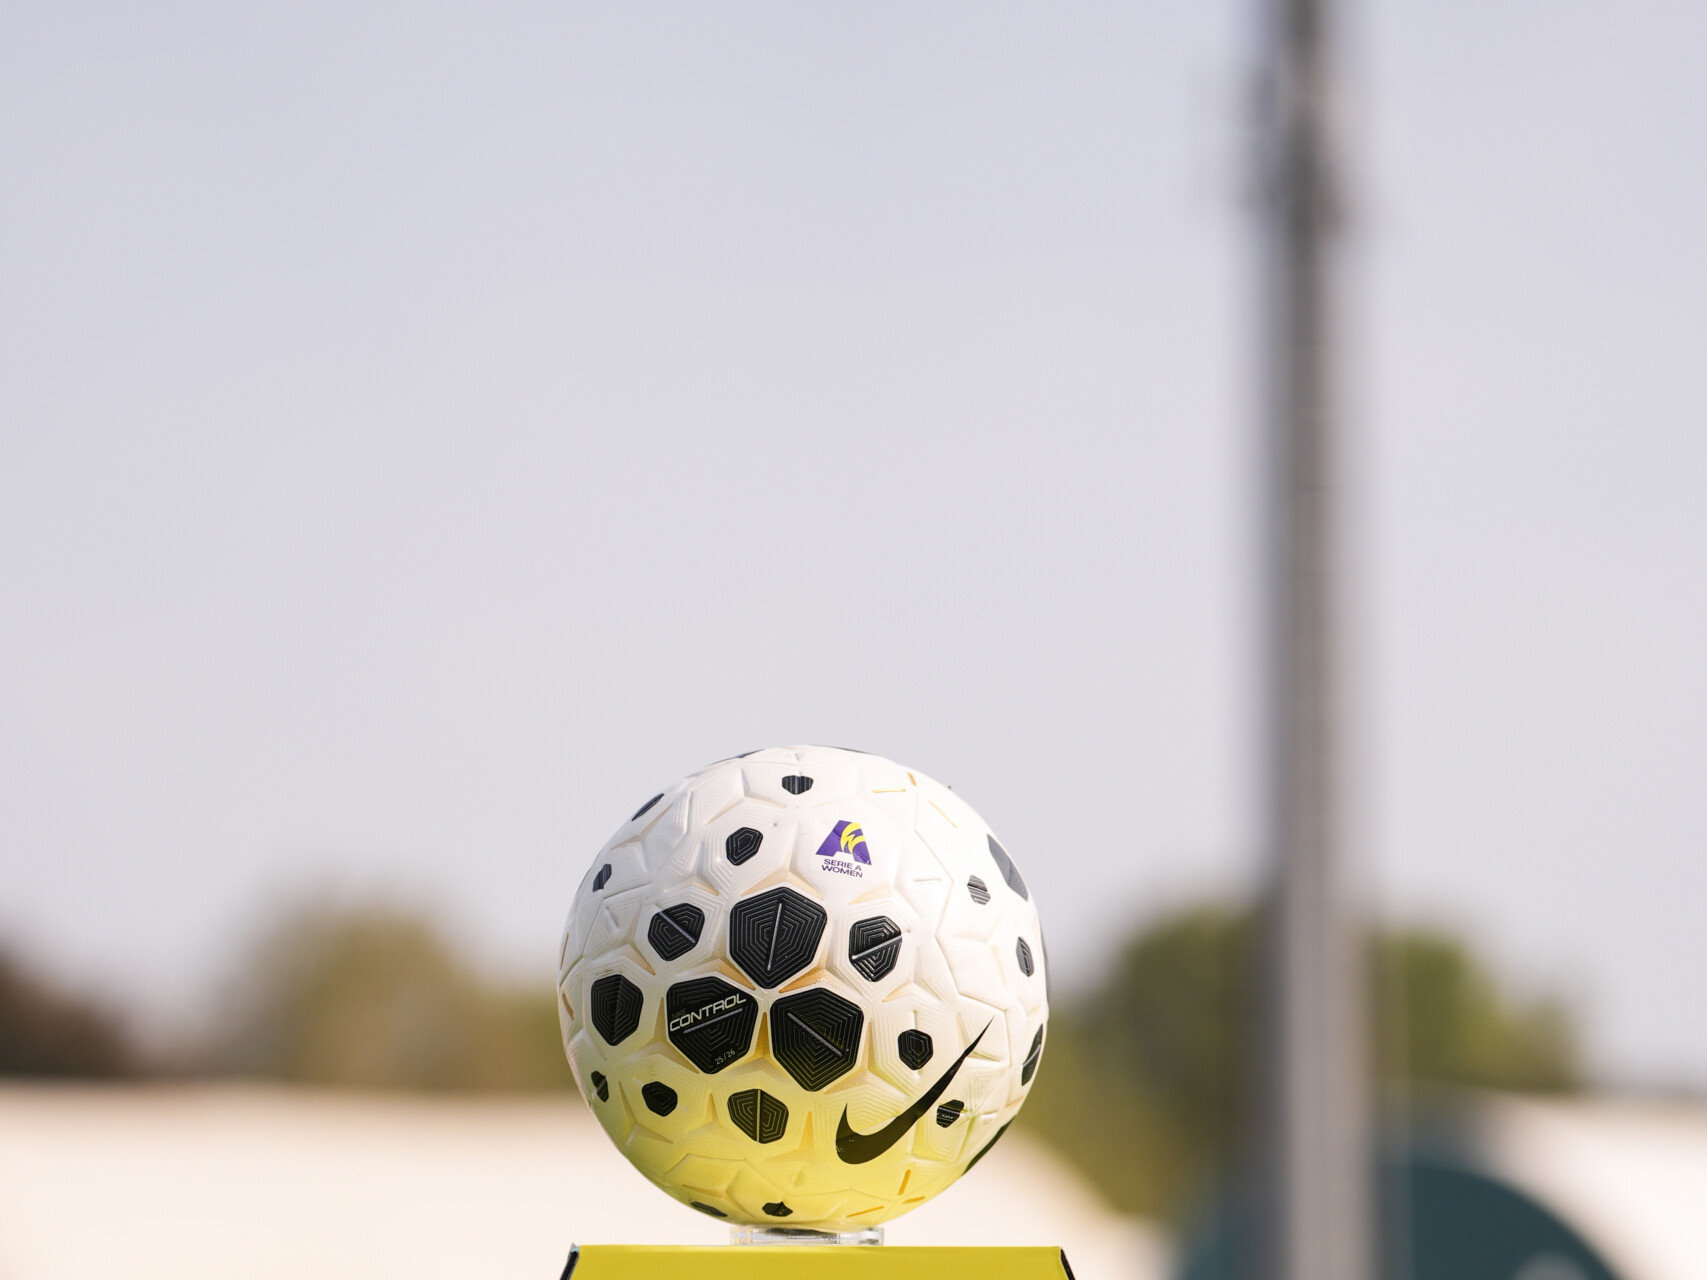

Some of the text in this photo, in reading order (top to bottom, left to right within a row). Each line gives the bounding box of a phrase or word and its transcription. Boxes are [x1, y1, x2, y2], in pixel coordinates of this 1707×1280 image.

[824, 858, 853, 869] SERIE
[821, 865, 863, 878] WOMEN
[670, 994, 746, 1031] CONTROL
